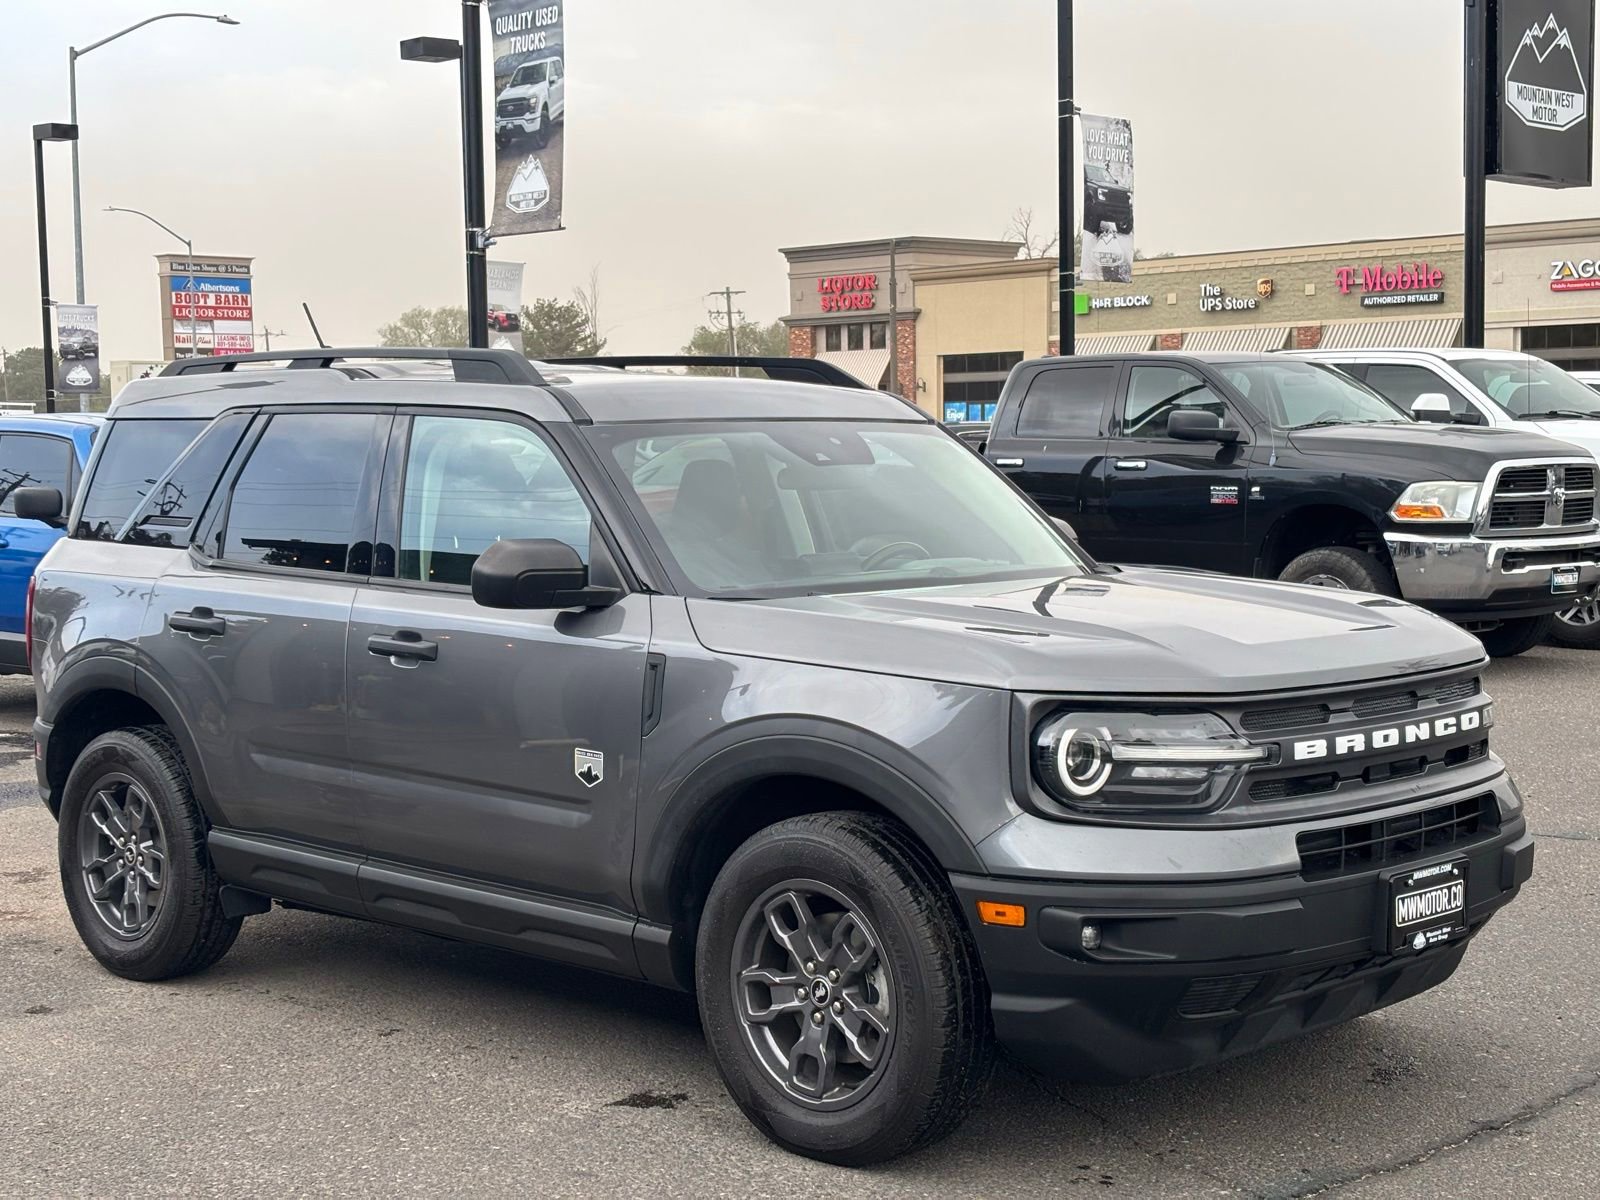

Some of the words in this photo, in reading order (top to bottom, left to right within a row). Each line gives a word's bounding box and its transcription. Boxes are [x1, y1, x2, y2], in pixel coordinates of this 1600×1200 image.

[495, 11, 533, 35] QUALITY
[535, 5, 558, 27] USED
[510, 31, 546, 54] TRUCKS
[1516, 84, 1553, 106] MOUNTAIN
[1554, 91, 1575, 109] WEST
[1531, 105, 1558, 123] MOTOR
[1086, 127, 1105, 143] LOVE
[1106, 130, 1129, 146] WHAT
[1088, 145, 1103, 160] YOU
[1105, 147, 1129, 163] DRIVE
[200, 283, 240, 292] Albertsons
[817, 274, 876, 294] LIQUOR
[1335, 263, 1444, 294] T-Mobile
[1200, 284, 1221, 296] The
[1364, 295, 1406, 305] AUTHORIZED
[1407, 293, 1439, 303] RETAILER
[175, 293, 209, 305] BOOT
[214, 294, 249, 306] BARN
[821, 292, 873, 313] STORE
[1092, 298, 1111, 309] H&R
[1114, 295, 1149, 307] BLOCK
[1200, 298, 1223, 312] UPS
[1226, 297, 1256, 309] Store
[175, 308, 215, 318] LIQUOR
[216, 309, 250, 318] STORE
[1294, 711, 1480, 760] BRONCO
[1399, 885, 1462, 922] MWMOTOR.CO
